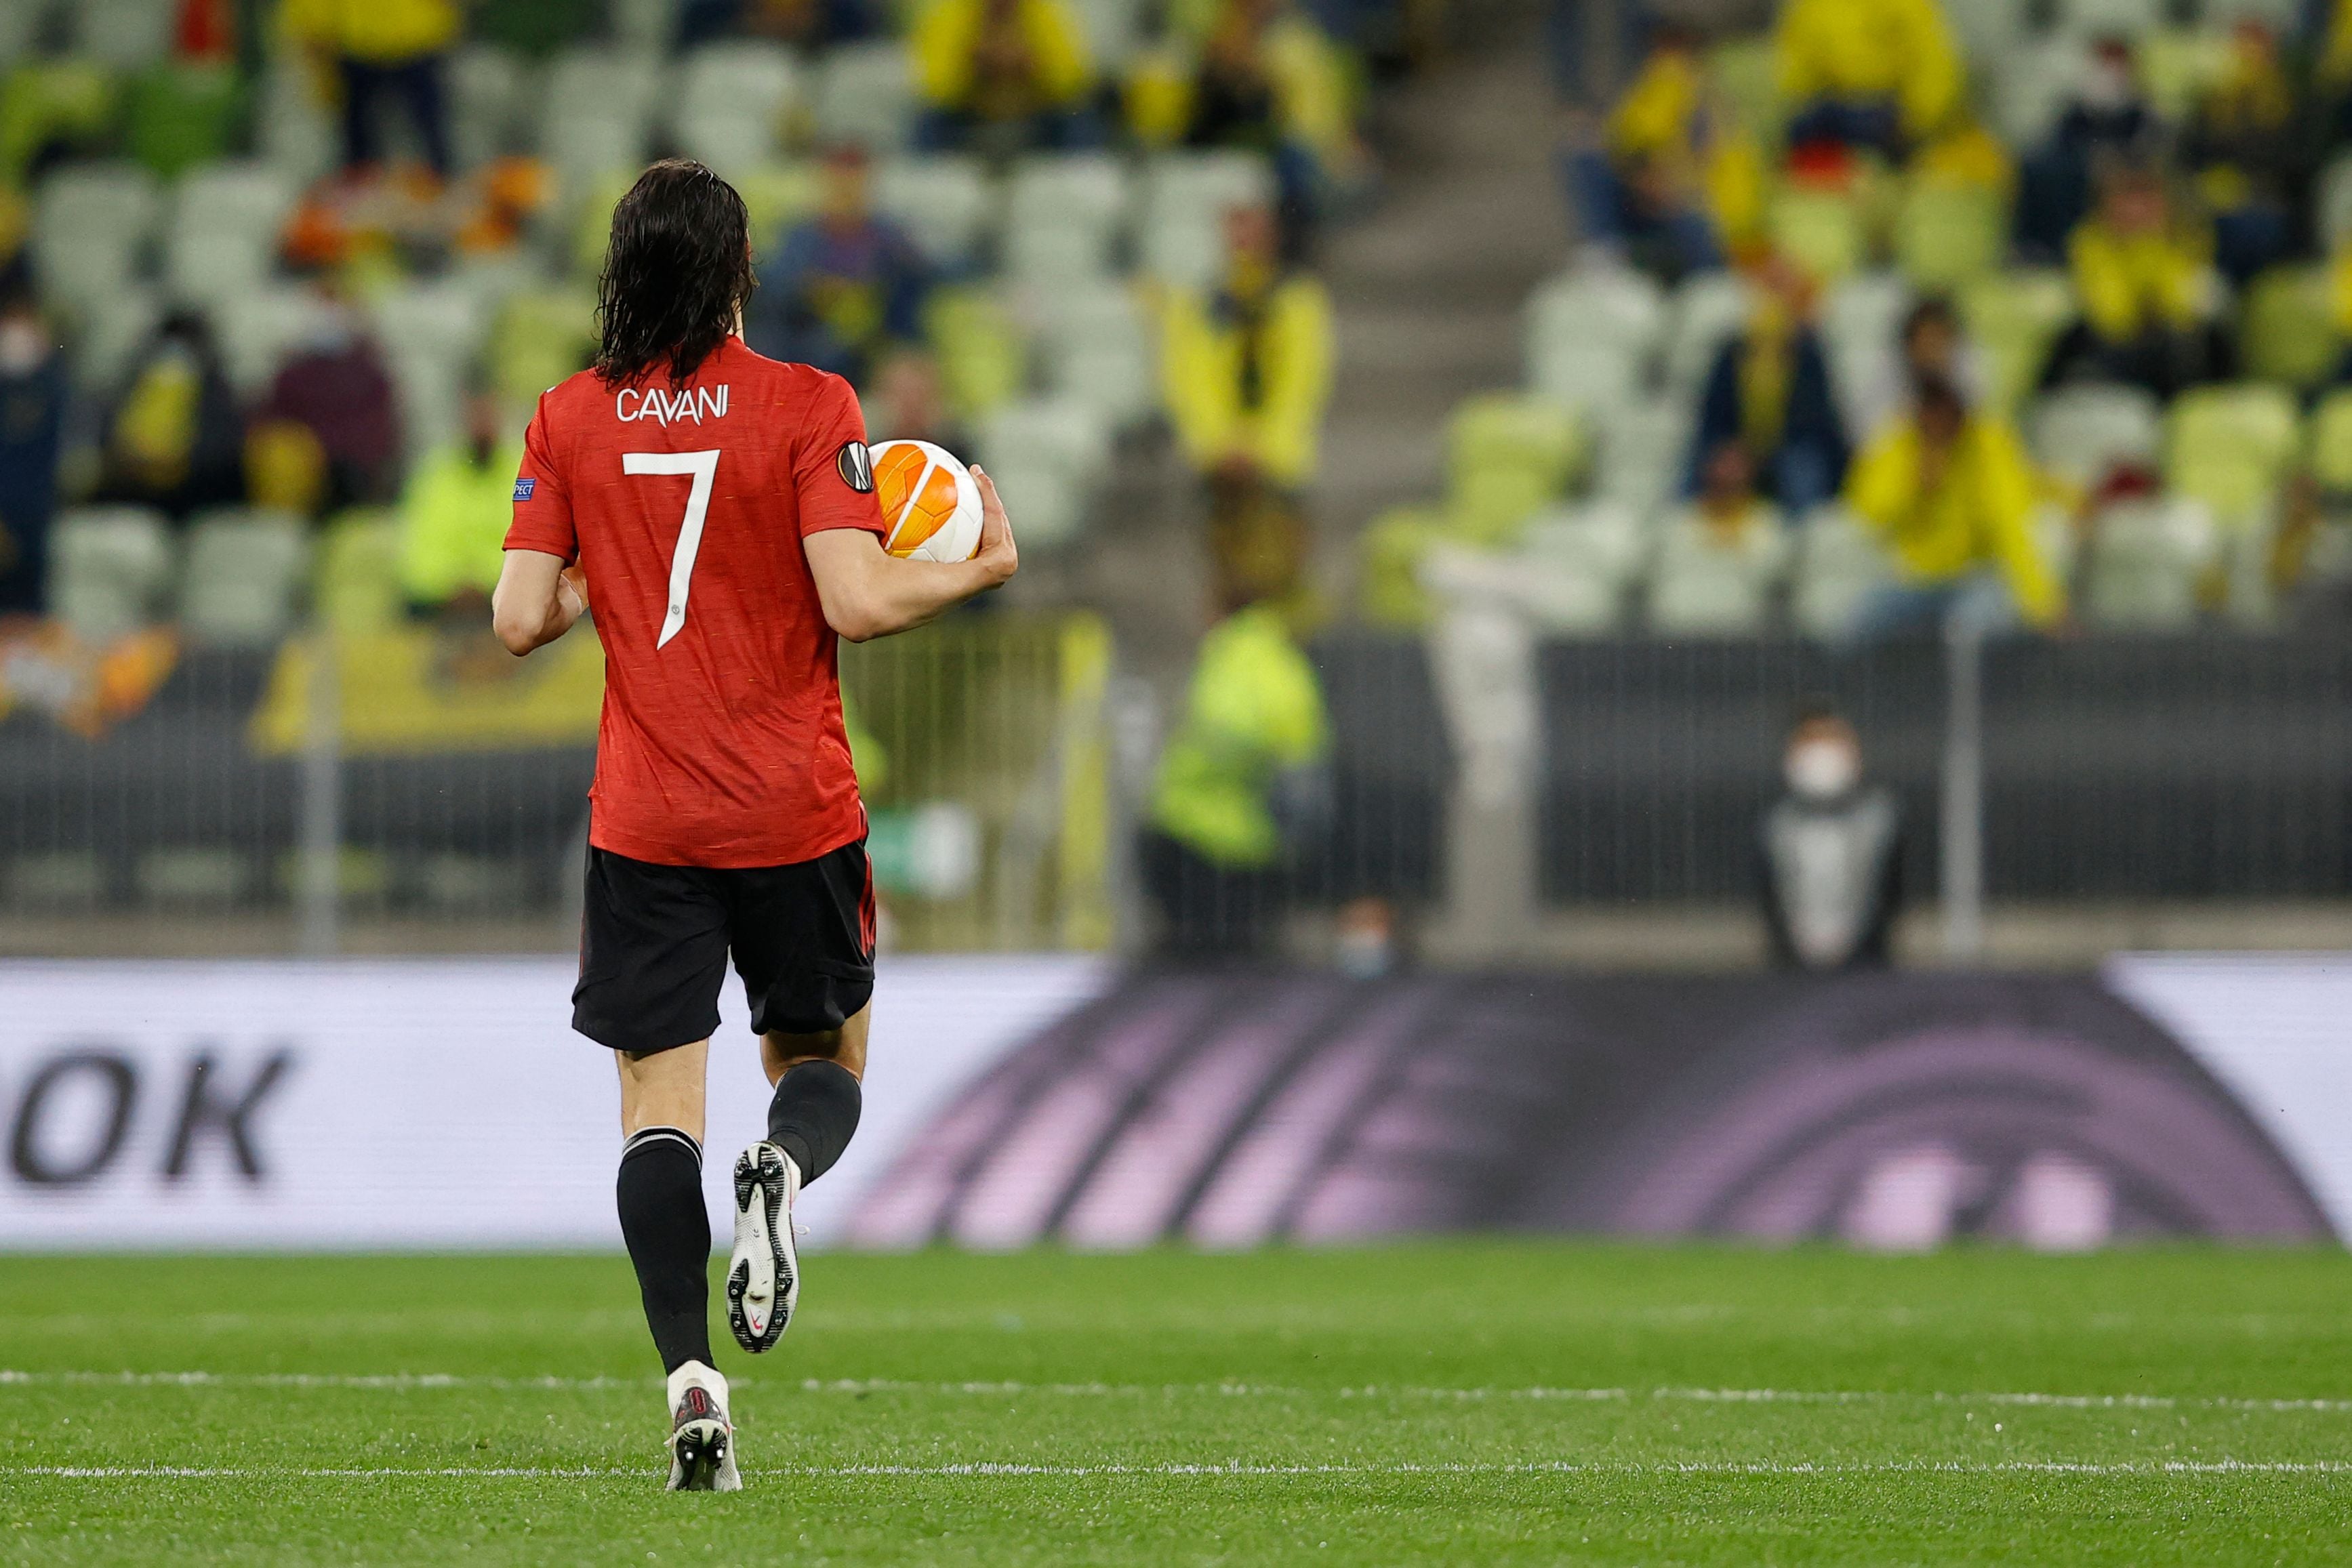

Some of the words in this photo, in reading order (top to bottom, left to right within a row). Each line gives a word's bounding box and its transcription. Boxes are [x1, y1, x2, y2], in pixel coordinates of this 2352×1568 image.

[617, 384, 729, 428] CAVANI
[622, 449, 721, 651] 7
[8, 1052, 294, 1183] OK
